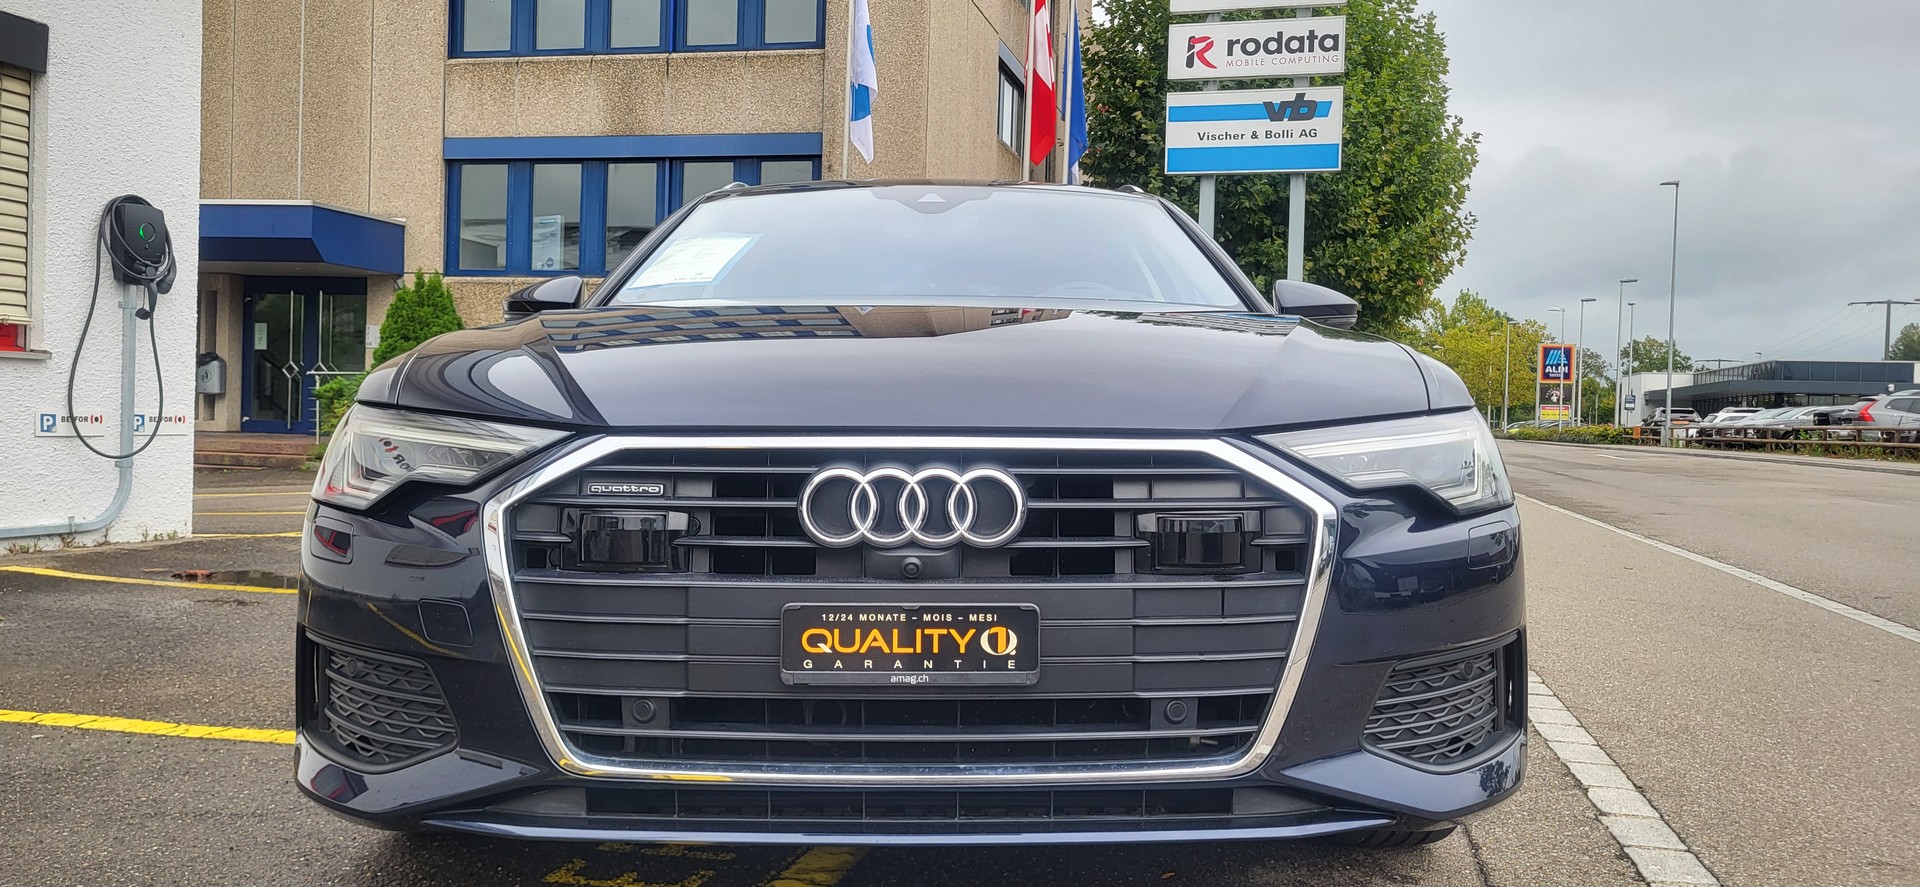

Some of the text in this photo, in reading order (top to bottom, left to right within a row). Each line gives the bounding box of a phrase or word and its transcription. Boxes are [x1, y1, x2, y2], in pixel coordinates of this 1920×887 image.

[1226, 30, 1340, 57] rodata
[1225, 55, 1340, 67] MOBILE COMPUTING
[1197, 128, 1318, 141] Vischer & Bolli AG
[61, 415, 89, 423] BEFOR
[149, 415, 173, 423] BEFOR
[590, 485, 660, 493] quattro
[821, 613, 854, 622] 12/24
[859, 613, 907, 622] MONATE
[923, 613, 953, 622] MOIS
[969, 613, 998, 622] MESI
[801, 628, 977, 654] QUALITY
[890, 674, 929, 684] amag.ch
